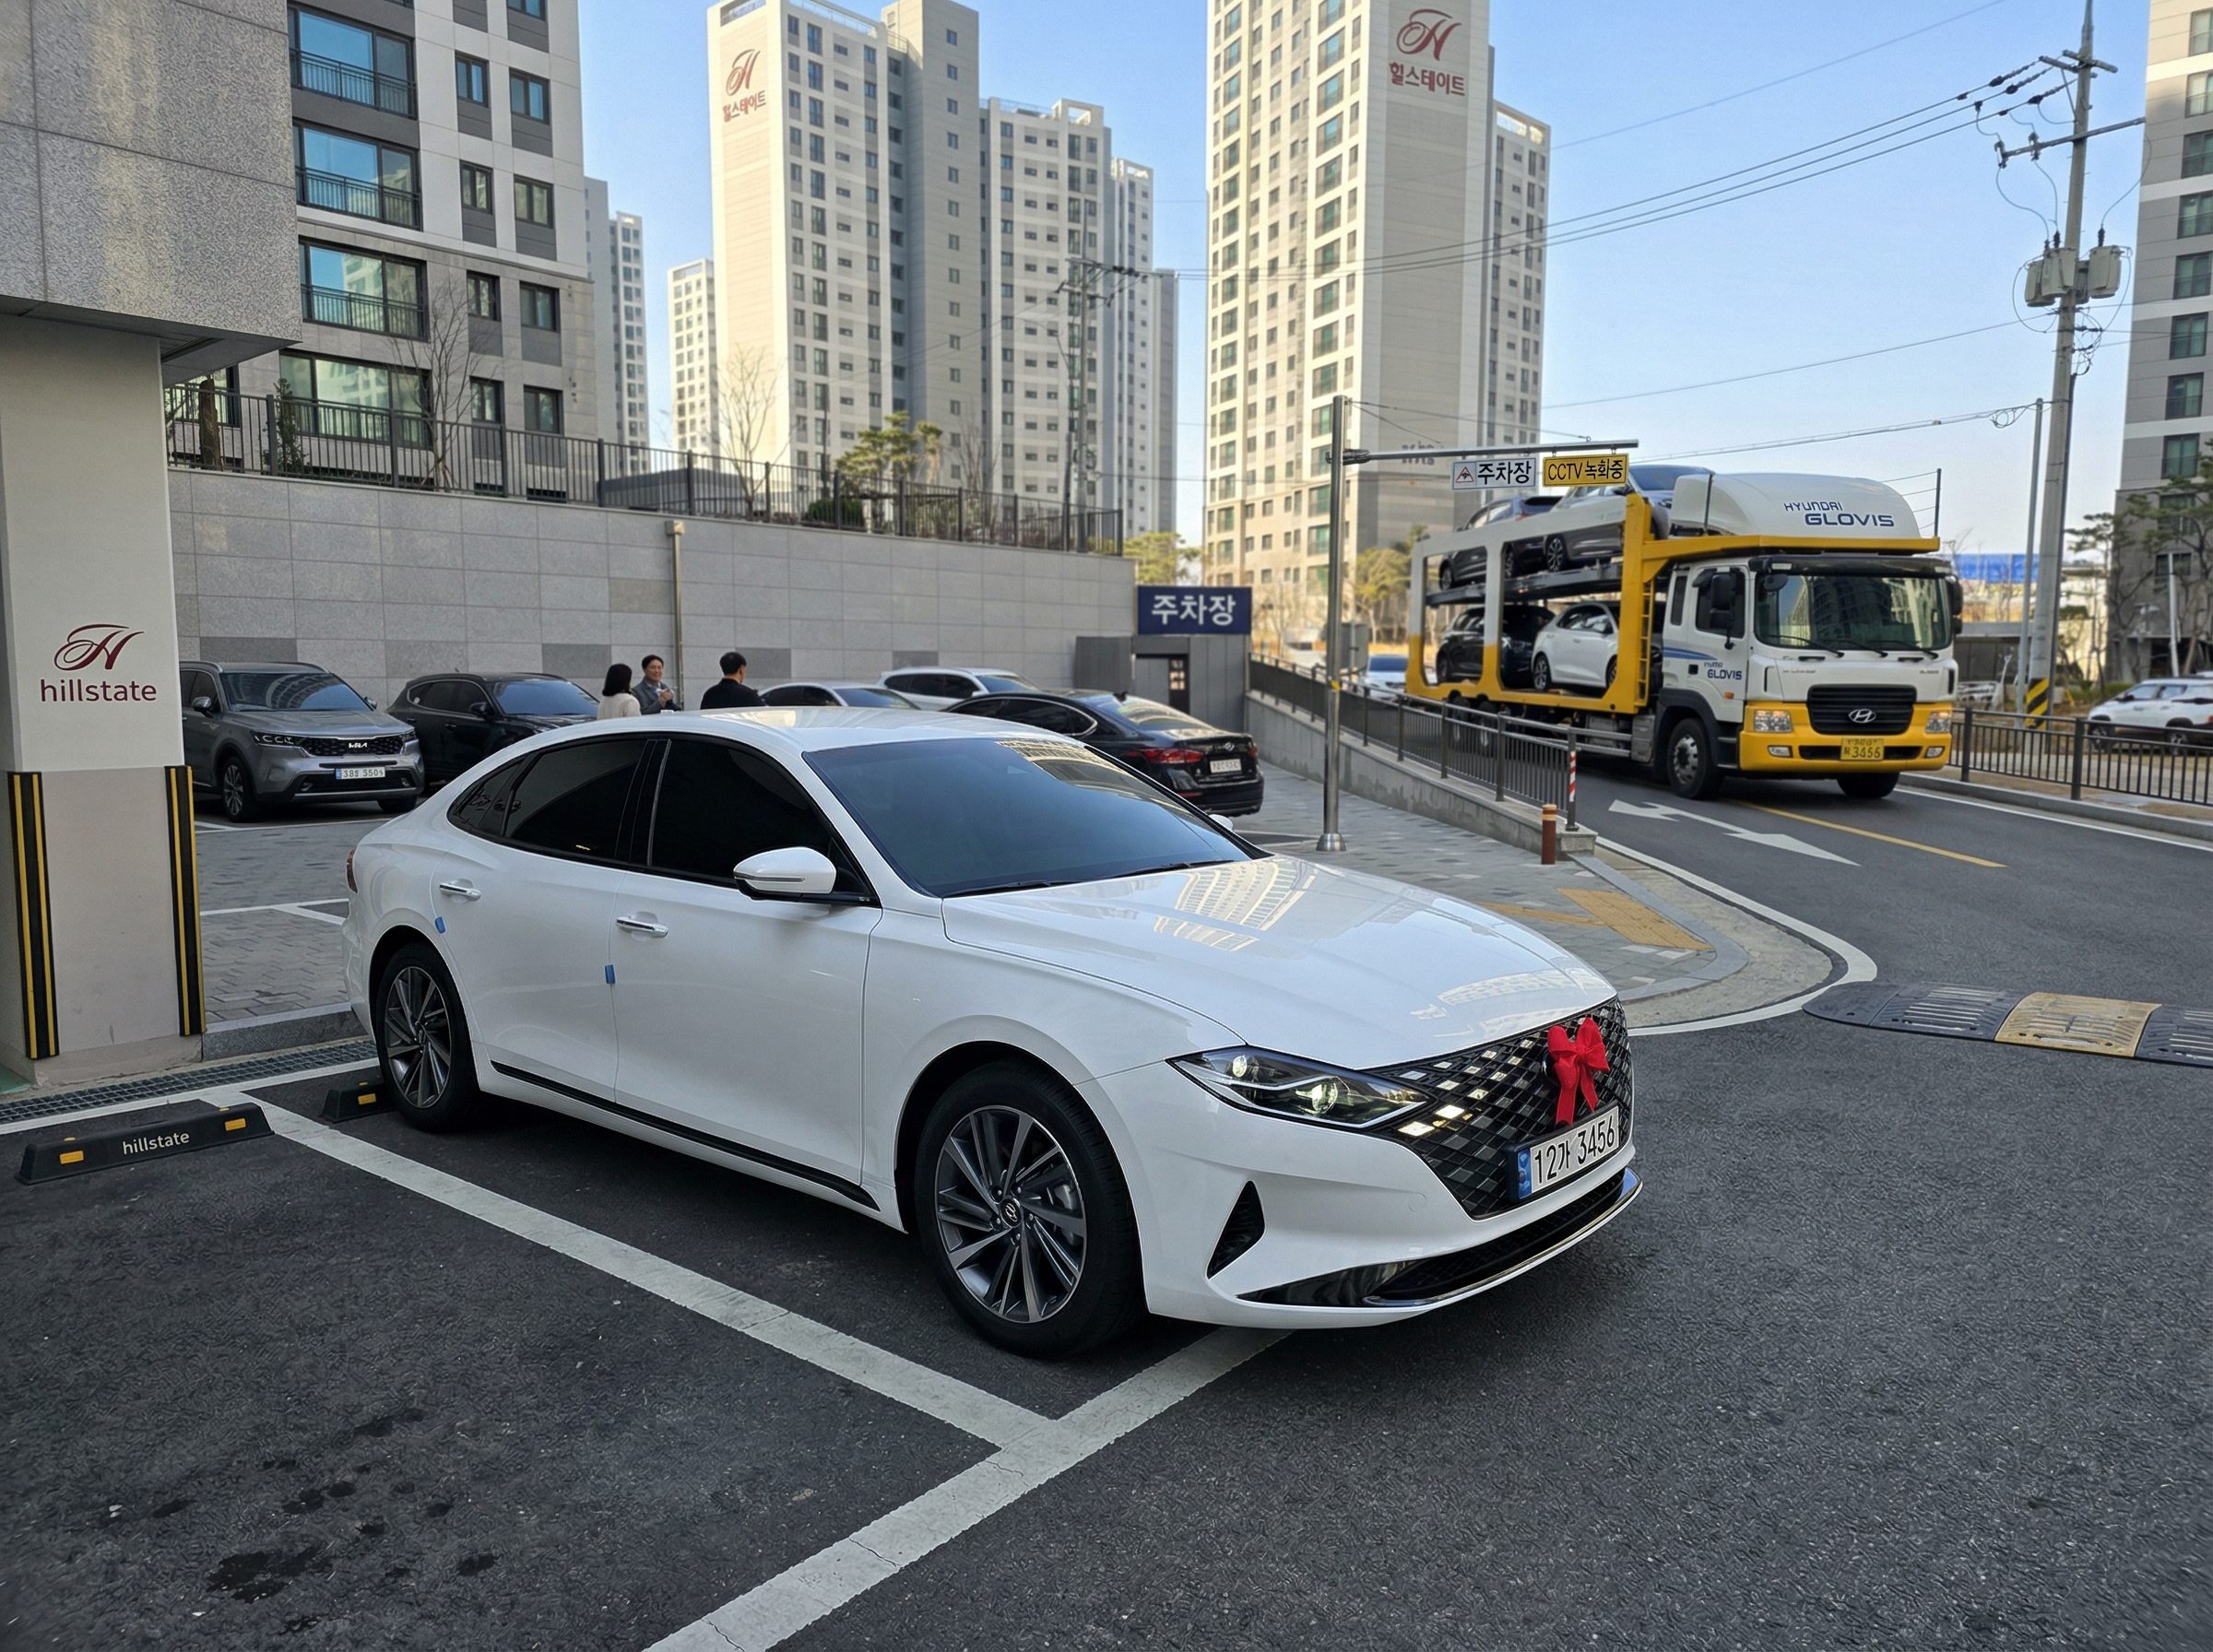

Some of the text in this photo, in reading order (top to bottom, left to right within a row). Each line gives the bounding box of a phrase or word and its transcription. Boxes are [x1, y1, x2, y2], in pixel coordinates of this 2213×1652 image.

[1389, 62, 1465, 96] 힐스테이트
[1477, 460, 1532, 485] 주차장
[1548, 462, 1583, 480] CCTV
[1783, 502, 1843, 512] HYUNDAI
[1805, 513, 1895, 527] GLOVIS
[1151, 594, 1237, 626] 주차장
[1707, 668, 1743, 680] GLOVIS
[41, 678, 157, 702] hillstate
[123, 1132, 190, 1155] hillstate
[1534, 1115, 1615, 1184] 12가 3456
